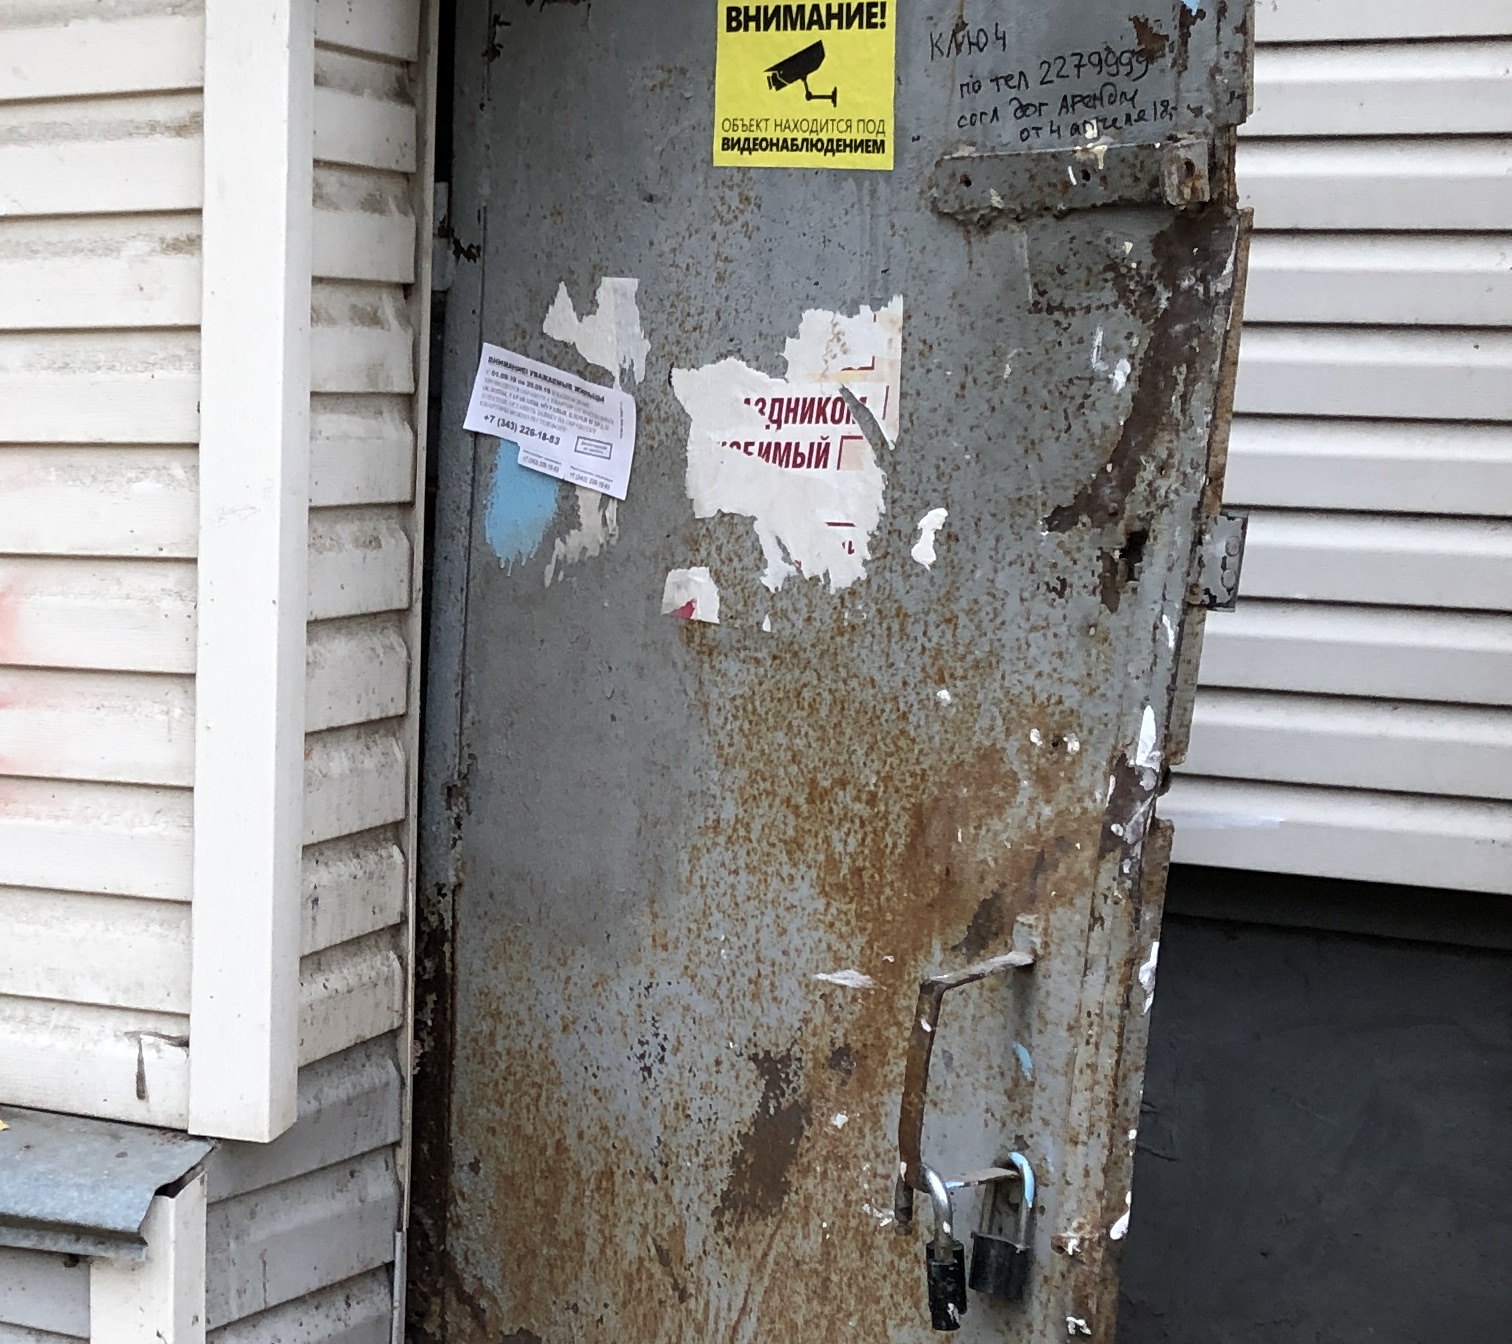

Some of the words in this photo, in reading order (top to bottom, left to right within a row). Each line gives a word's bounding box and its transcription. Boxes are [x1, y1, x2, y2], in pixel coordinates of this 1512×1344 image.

[725, 1, 887, 33] ВНИМАНИЕ!
[989, 70, 1029, 92] тел
[721, 117, 771, 133] ОБЪЕКТ
[774, 118, 853, 136] НАХОДИТСЯ
[856, 118, 886, 136] ПОД
[1019, 126, 1043, 143] от
[721, 136, 886, 156] ВИДЕОНАБЛЮДЕНИЕМ
[744, 396, 867, 431] ЗДНИКО
[496, 417, 518, 433] (343)
[719, 435, 831, 470] БИМЫЙ
